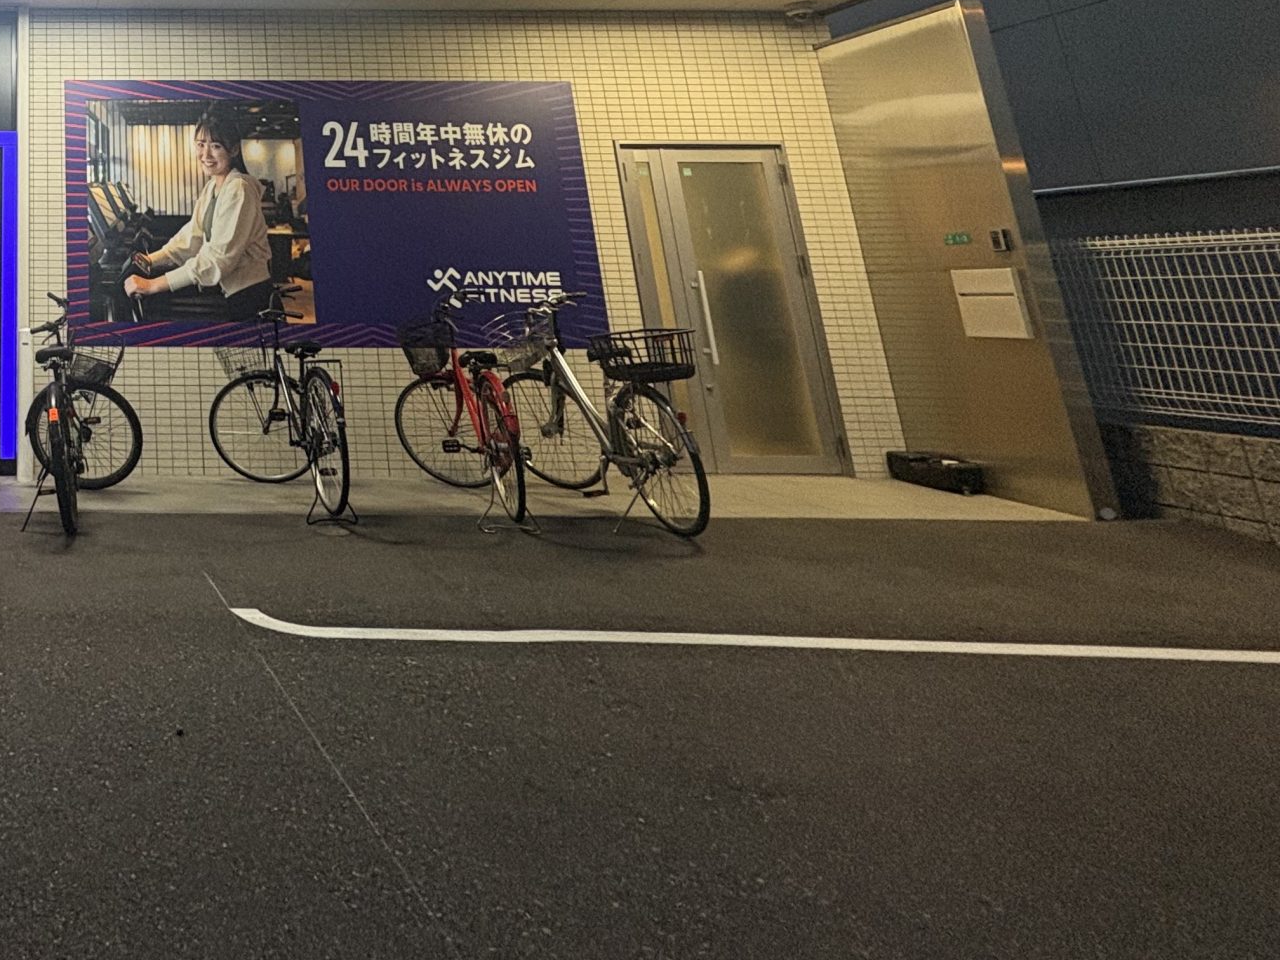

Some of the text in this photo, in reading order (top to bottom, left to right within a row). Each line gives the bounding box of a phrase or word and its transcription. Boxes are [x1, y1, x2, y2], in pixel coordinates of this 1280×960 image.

[322, 121, 369, 168] 24
[369, 122, 533, 146] 時間年中無休の
[372, 148, 535, 170] フィットネスジム
[327, 178, 537, 193] OUR DOOR is ALWAYS OPEN
[464, 271, 561, 286] ANYTIME
